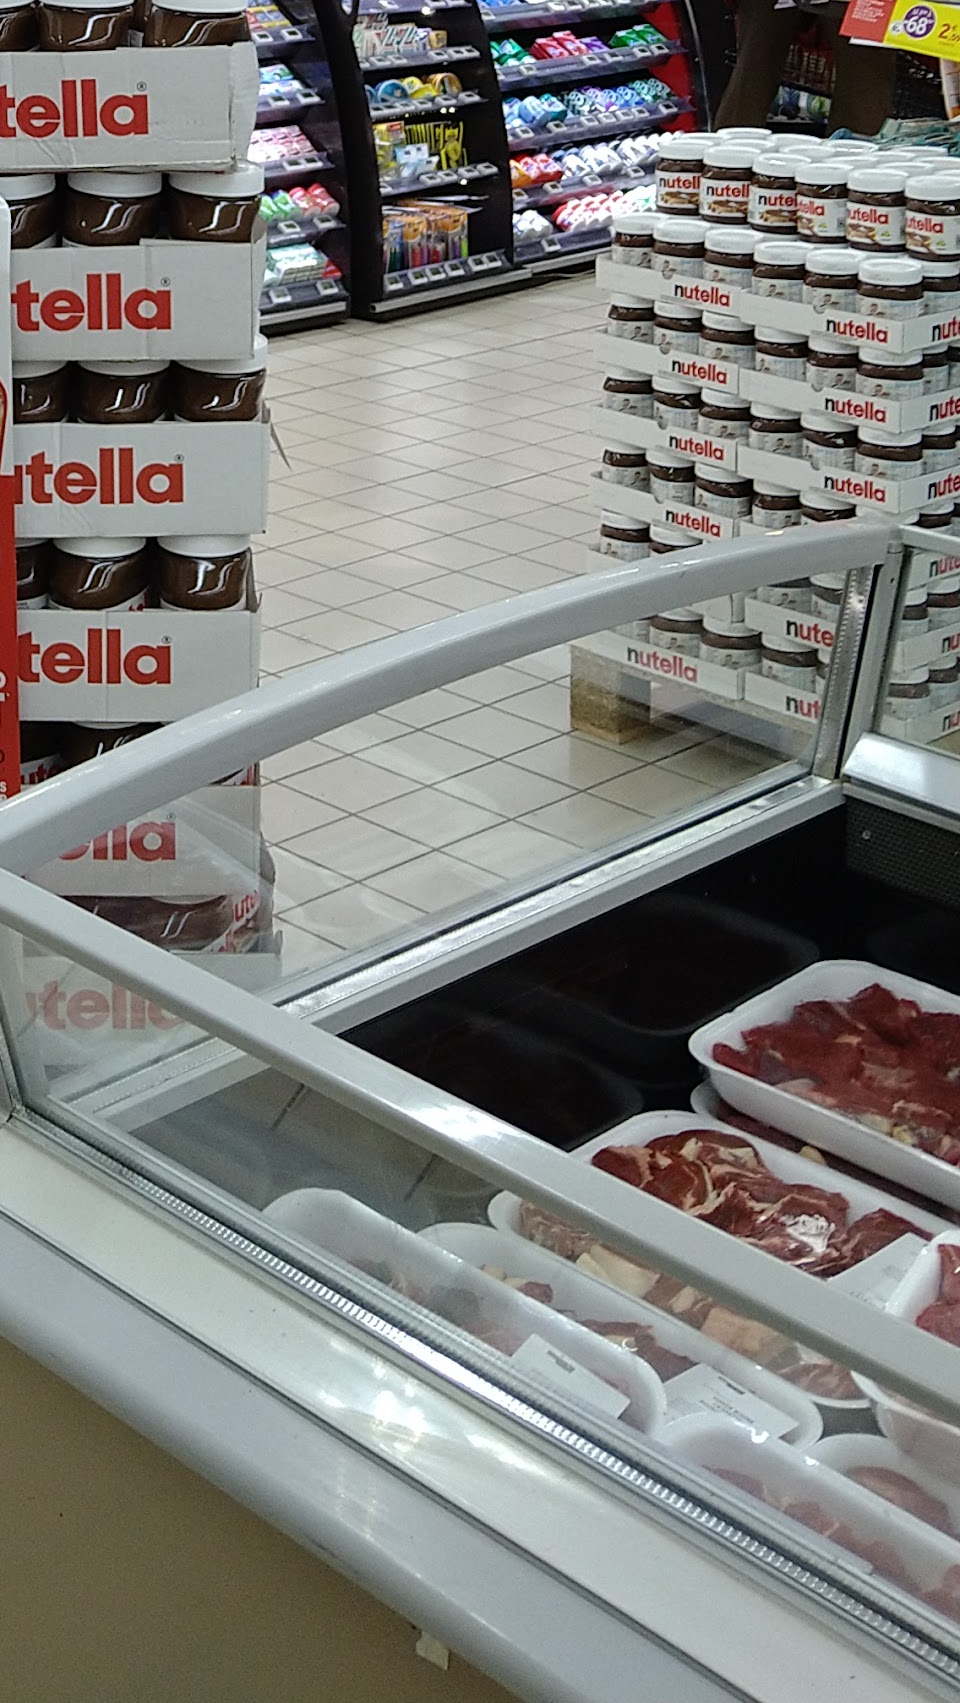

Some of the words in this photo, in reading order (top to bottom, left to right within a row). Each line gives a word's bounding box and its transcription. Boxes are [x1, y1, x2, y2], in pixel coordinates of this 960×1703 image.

[674, 282, 730, 307] nutella
[826, 317, 888, 343] nutella
[669, 434, 724, 461] nutella
[665, 509, 721, 538] nutella
[628, 646, 698, 683] nutella
